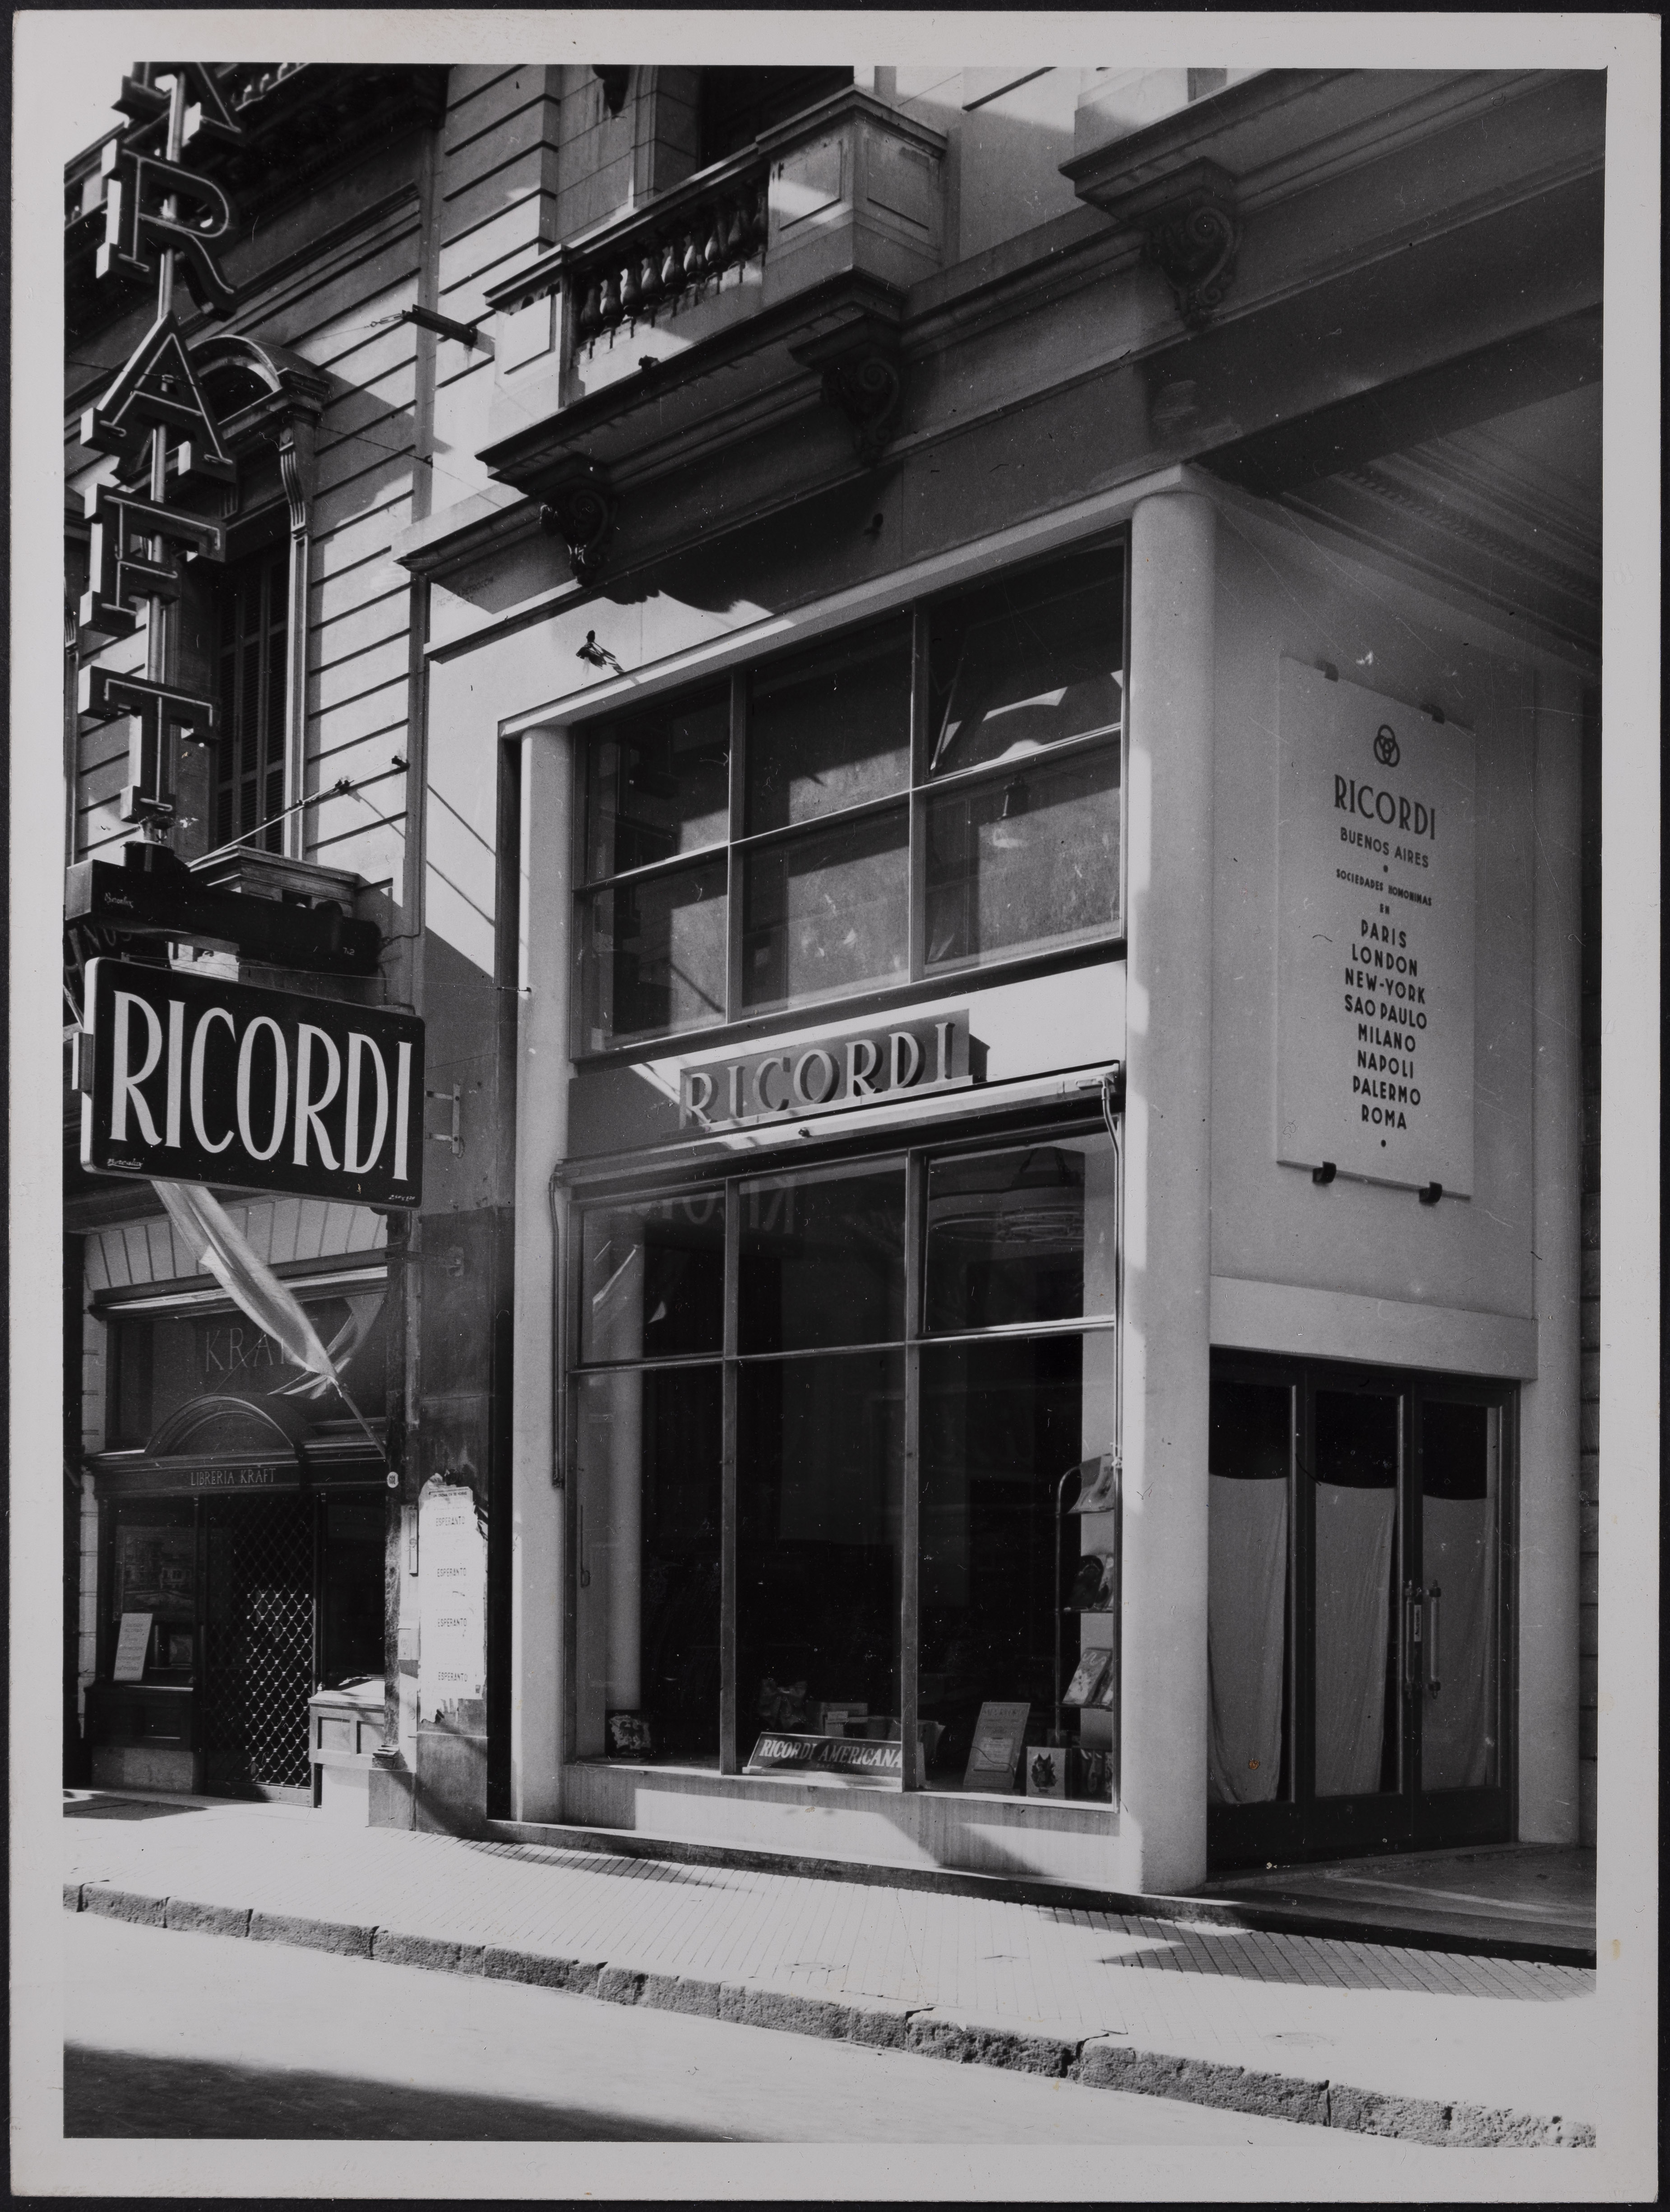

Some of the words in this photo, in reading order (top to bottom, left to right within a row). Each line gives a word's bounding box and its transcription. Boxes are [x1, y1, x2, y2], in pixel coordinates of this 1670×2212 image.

[1334, 774, 1435, 840] RICORDI
[1340, 827, 1390, 856] BUENOS
[1394, 846, 1429, 868] AIRES
[1336, 869, 1383, 892] SOCIEDADES
[1388, 885, 1432, 907] HOMONIMAS
[1380, 903, 1390, 915] EN
[1361, 919, 1407, 948] PARIS
[1352, 944, 1417, 977] LONDON
[1345, 967, 1425, 1004] NEW-YORK
[1344, 994, 1376, 1017] SAO
[1380, 1003, 1427, 1029] PAULO
[1358, 1023, 1416, 1053] MILANO
[685, 1022, 956, 1124] RICORDI
[1358, 1050, 1414, 1079] NAPOLI
[110, 990, 413, 1181] RICORDI
[1353, 1075, 1421, 1106] PALERMO
[1361, 1104, 1407, 1129] ROMA
[191, 1470, 235, 1486] LIBRERIA
[240, 1468, 277, 1484] KRAFT
[436, 1516, 466, 1526] ESPERANTO
[437, 1568, 467, 1578] ESPERANTO
[437, 1618, 467, 1627] ESPERANTO
[438, 1671, 468, 1682] ESPERANTO
[759, 1740, 817, 1760] RICORDI
[818, 1745, 902, 1768] AMERICANA
